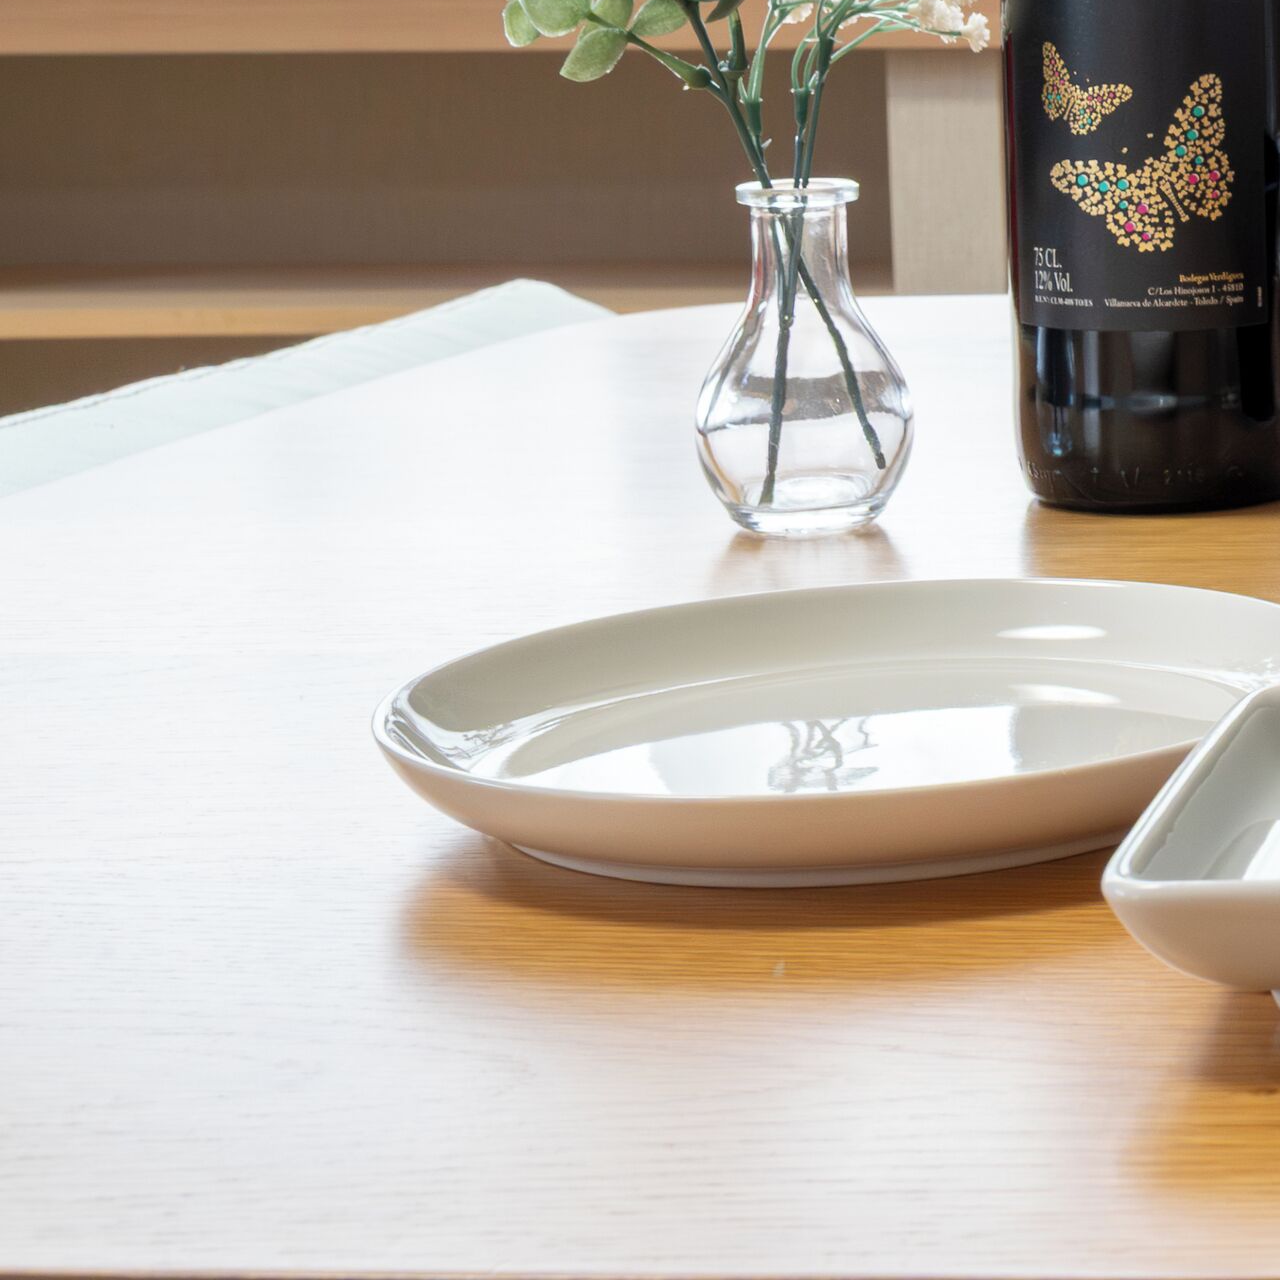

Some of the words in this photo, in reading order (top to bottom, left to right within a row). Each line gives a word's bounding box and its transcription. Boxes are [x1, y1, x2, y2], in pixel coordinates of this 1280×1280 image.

[1033, 246, 1044, 266] 75
[1045, 247, 1063, 268] CL.
[1034, 269, 1053, 291] 12%
[1053, 271, 1074, 293] Vol.
